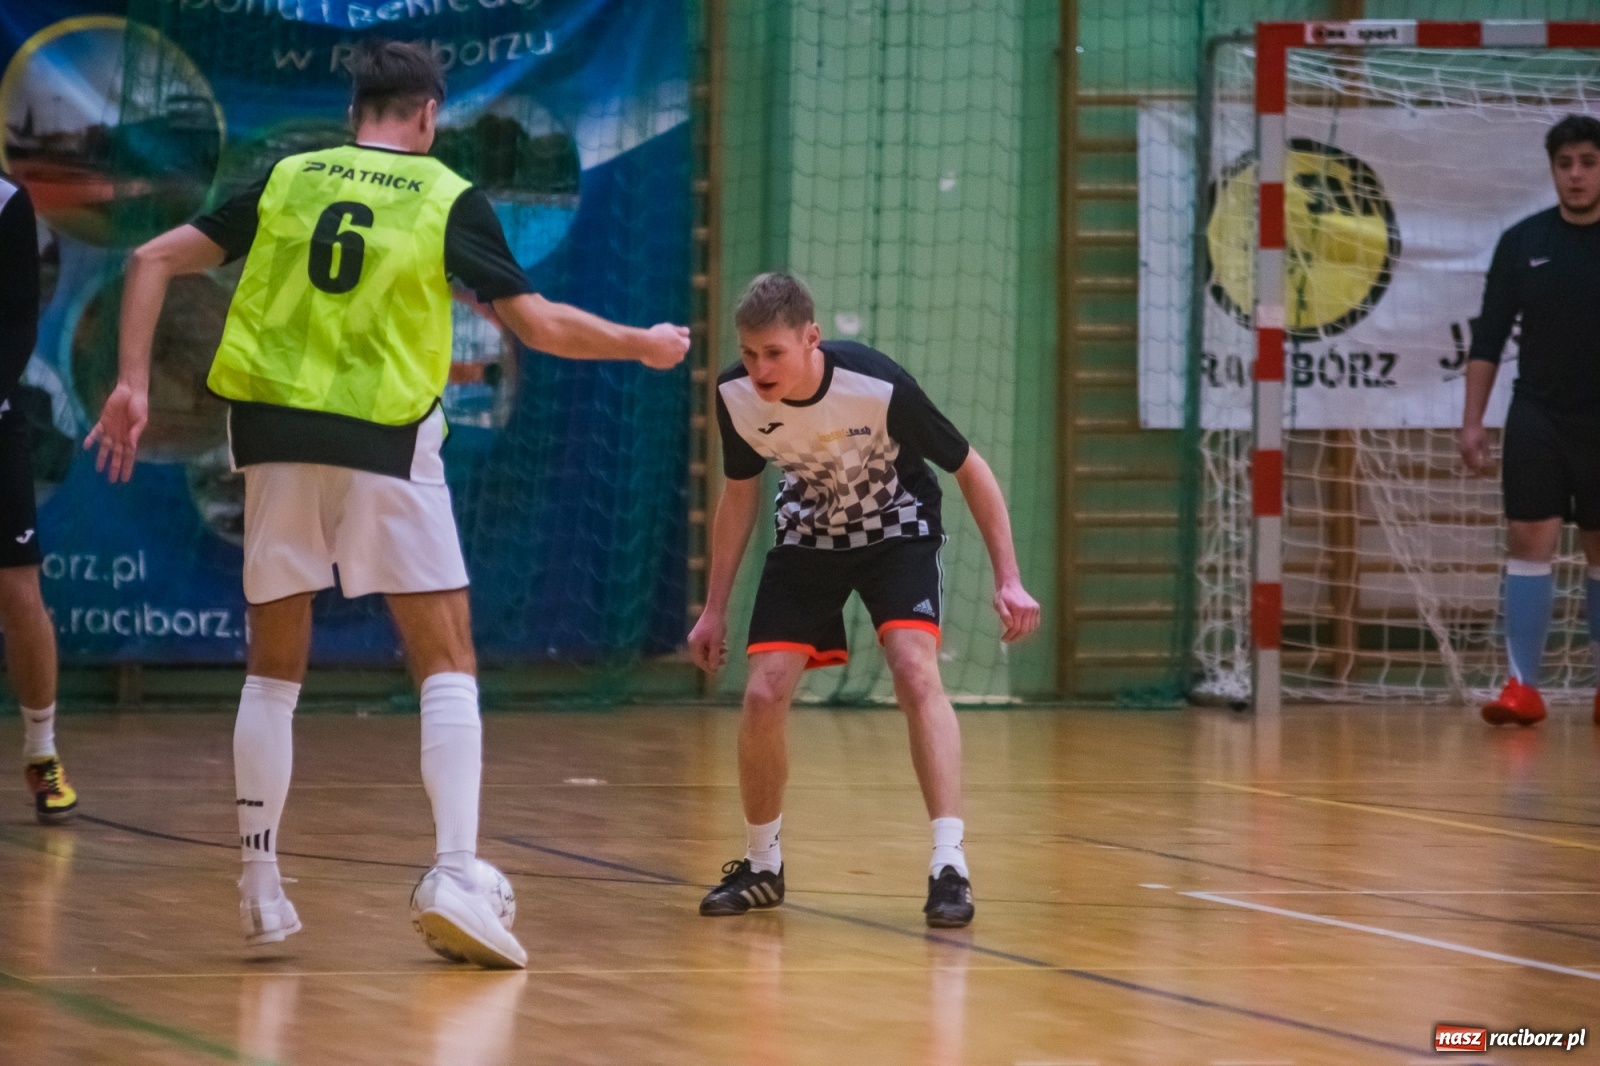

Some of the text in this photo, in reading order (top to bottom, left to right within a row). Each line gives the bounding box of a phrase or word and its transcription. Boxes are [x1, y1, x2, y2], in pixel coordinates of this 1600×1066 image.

[272, 31, 554, 73] w Rborzu
[328, 164, 424, 193] PATRICK
[308, 201, 375, 294] 6
[1201, 345, 1399, 389] RABÓRZ
[41, 549, 146, 590] orz.pl
